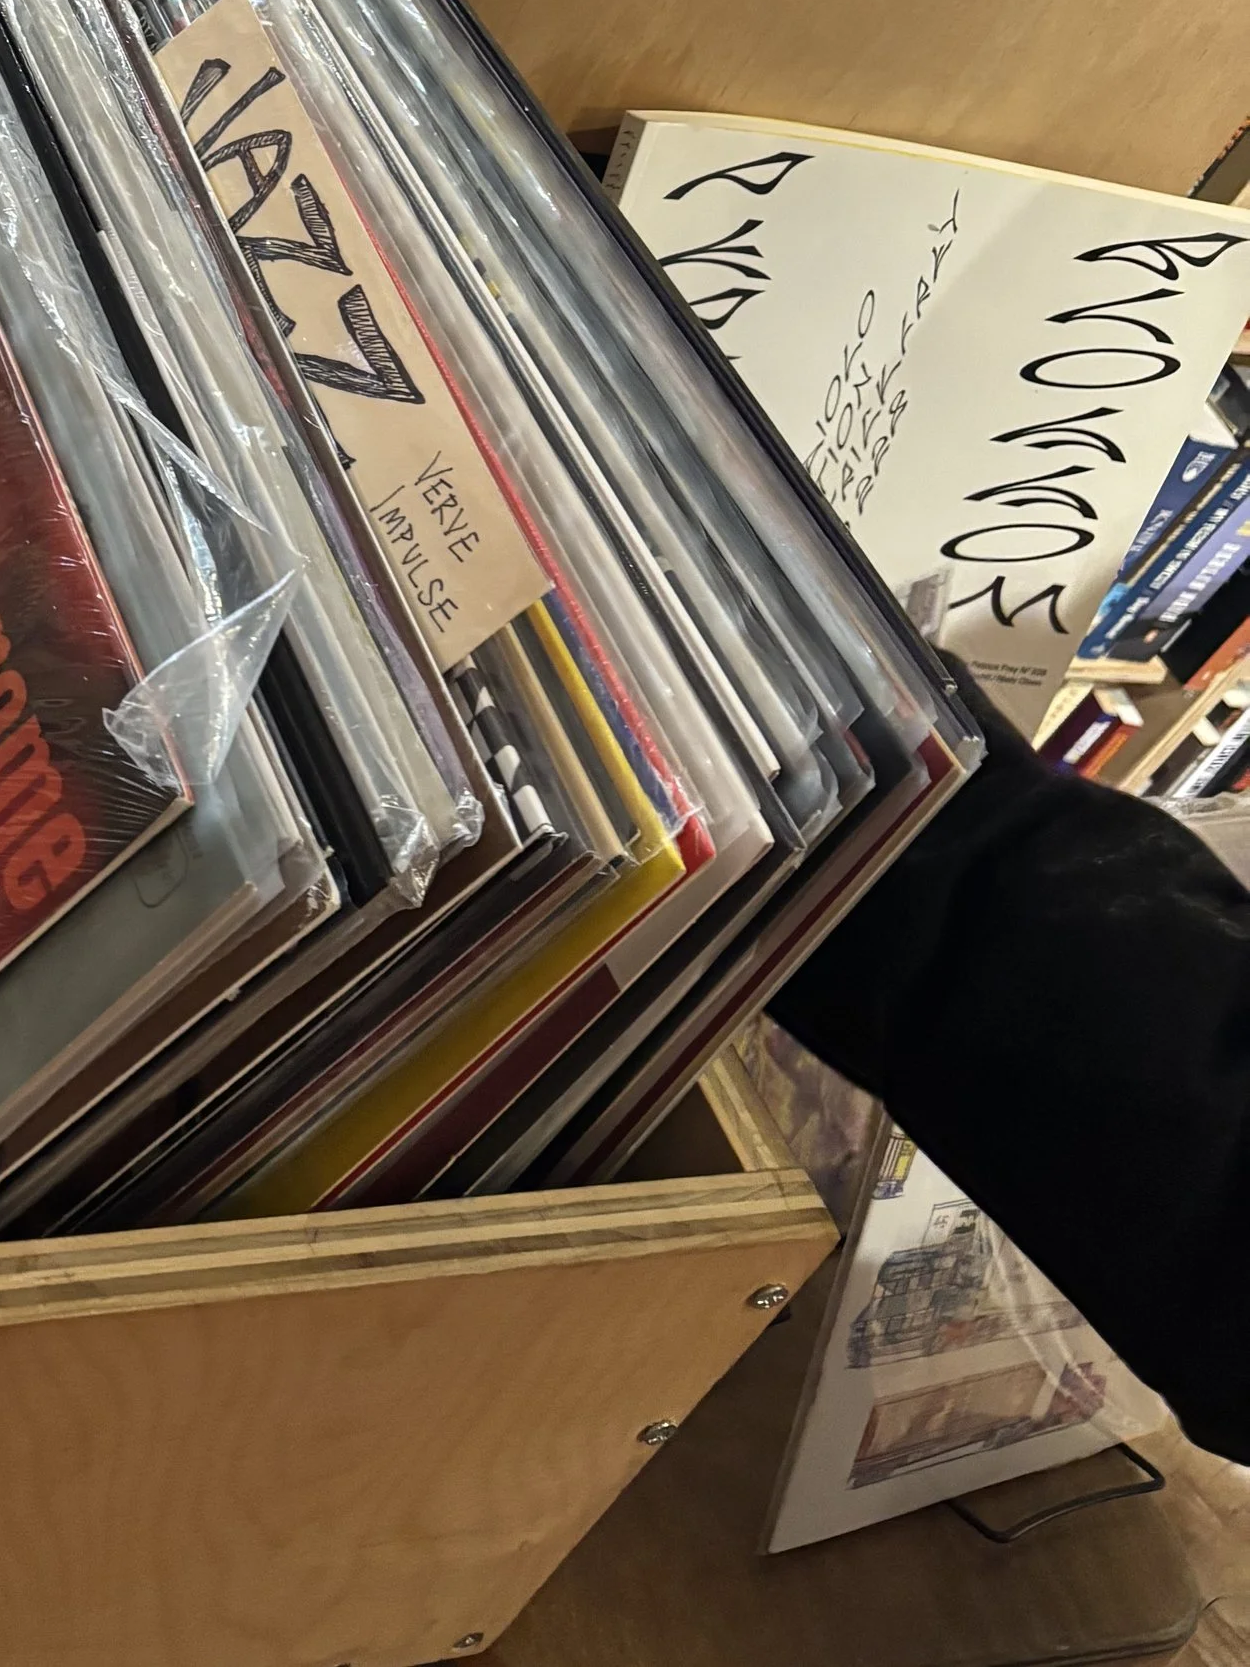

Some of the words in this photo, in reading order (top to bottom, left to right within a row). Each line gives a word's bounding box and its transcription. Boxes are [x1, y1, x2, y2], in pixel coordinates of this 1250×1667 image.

[181, 58, 426, 471] JAZZ
[370, 484, 461, 635] IMPULSE
[414, 450, 480, 564] VERVE
